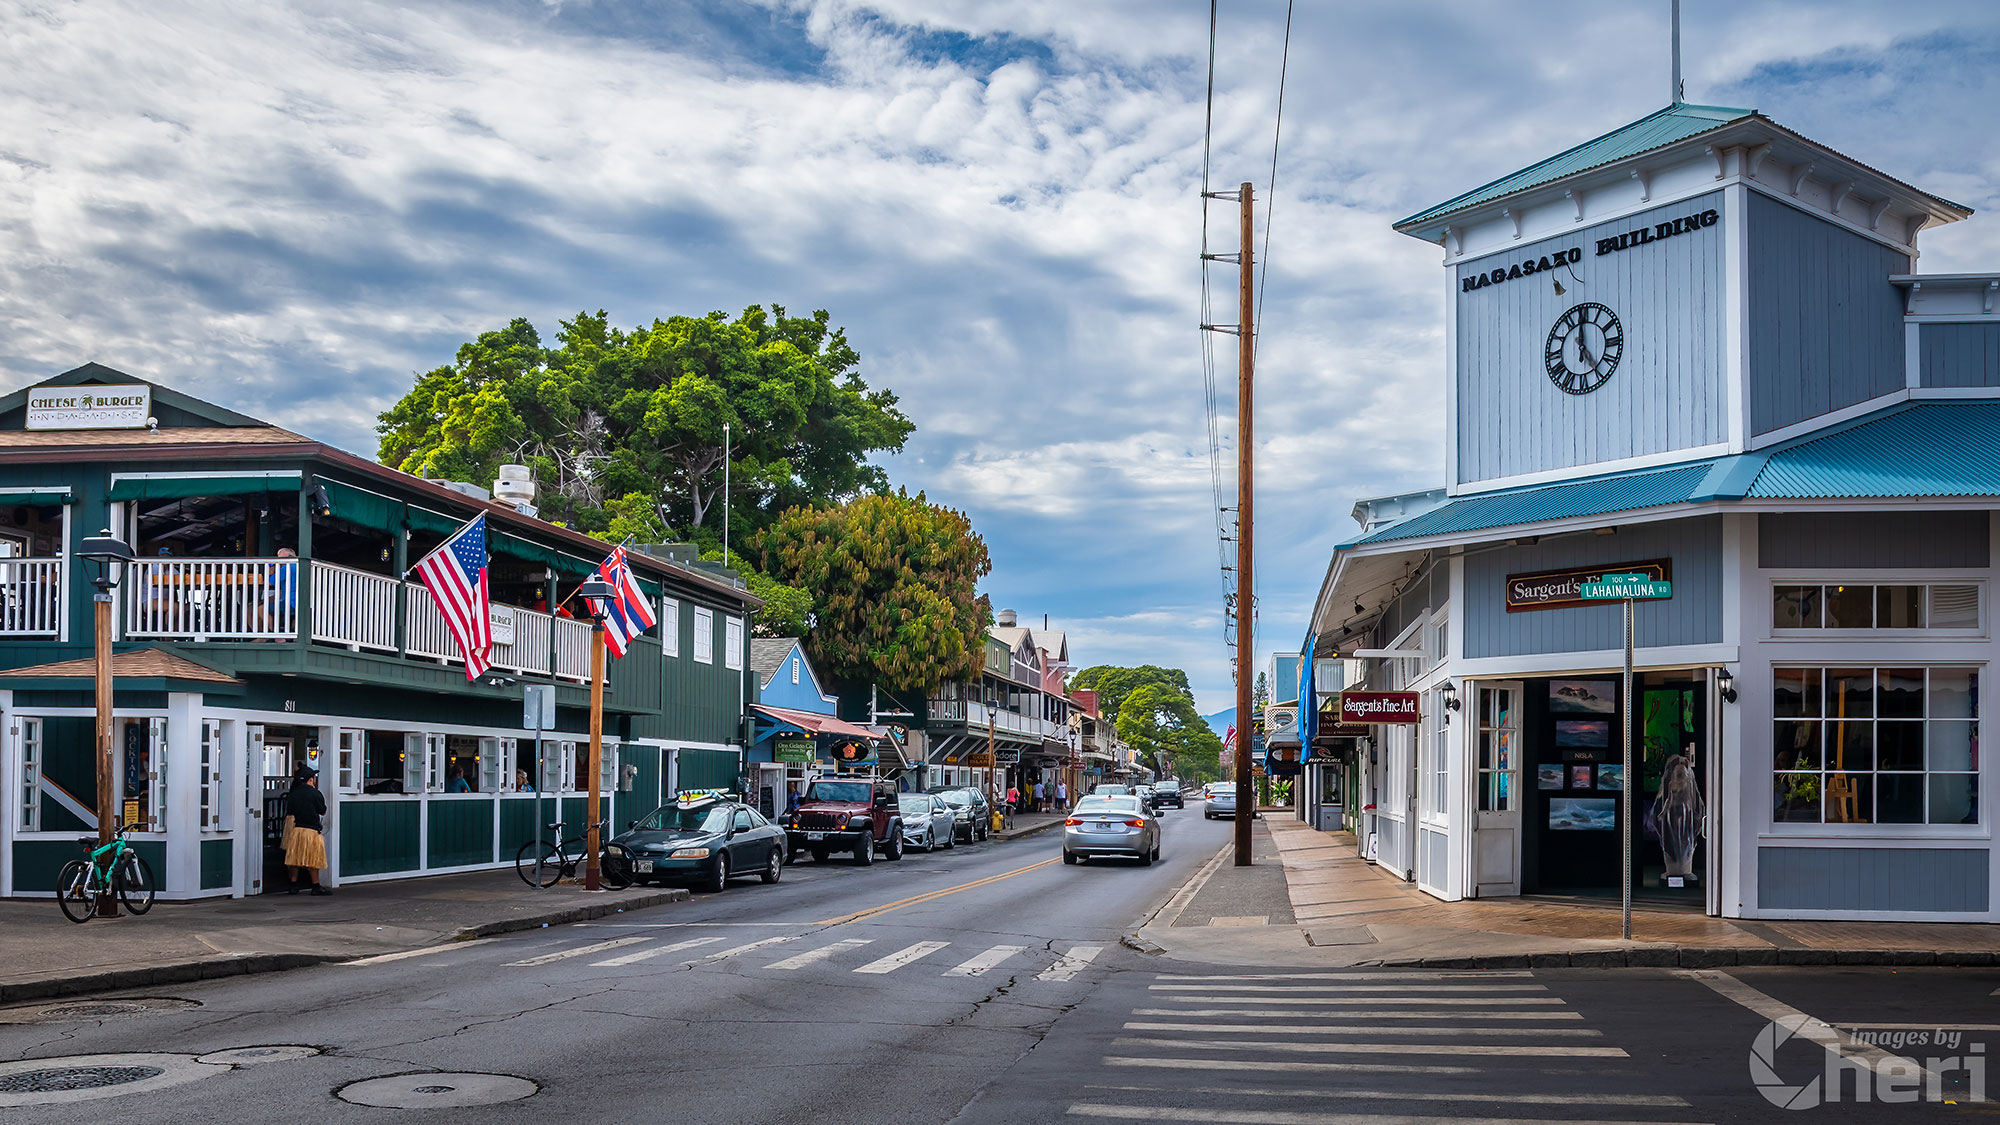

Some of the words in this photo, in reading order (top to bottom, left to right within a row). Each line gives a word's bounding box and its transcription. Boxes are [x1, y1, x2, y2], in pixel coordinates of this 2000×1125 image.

[1462, 247, 1582, 293] NAGASAKO
[1595, 208, 1719, 256] BUILDING
[31, 398, 77, 408] CHEESE
[96, 397, 143, 406] BURGER
[1612, 576, 1623, 584] 100
[1514, 577, 1581, 601] Sargent's
[1586, 584, 1655, 598] LAHAINALUNA
[285, 700, 296, 711] 811
[1400, 698, 1415, 713] Art
[128, 727, 137, 792] COCKTAILS
